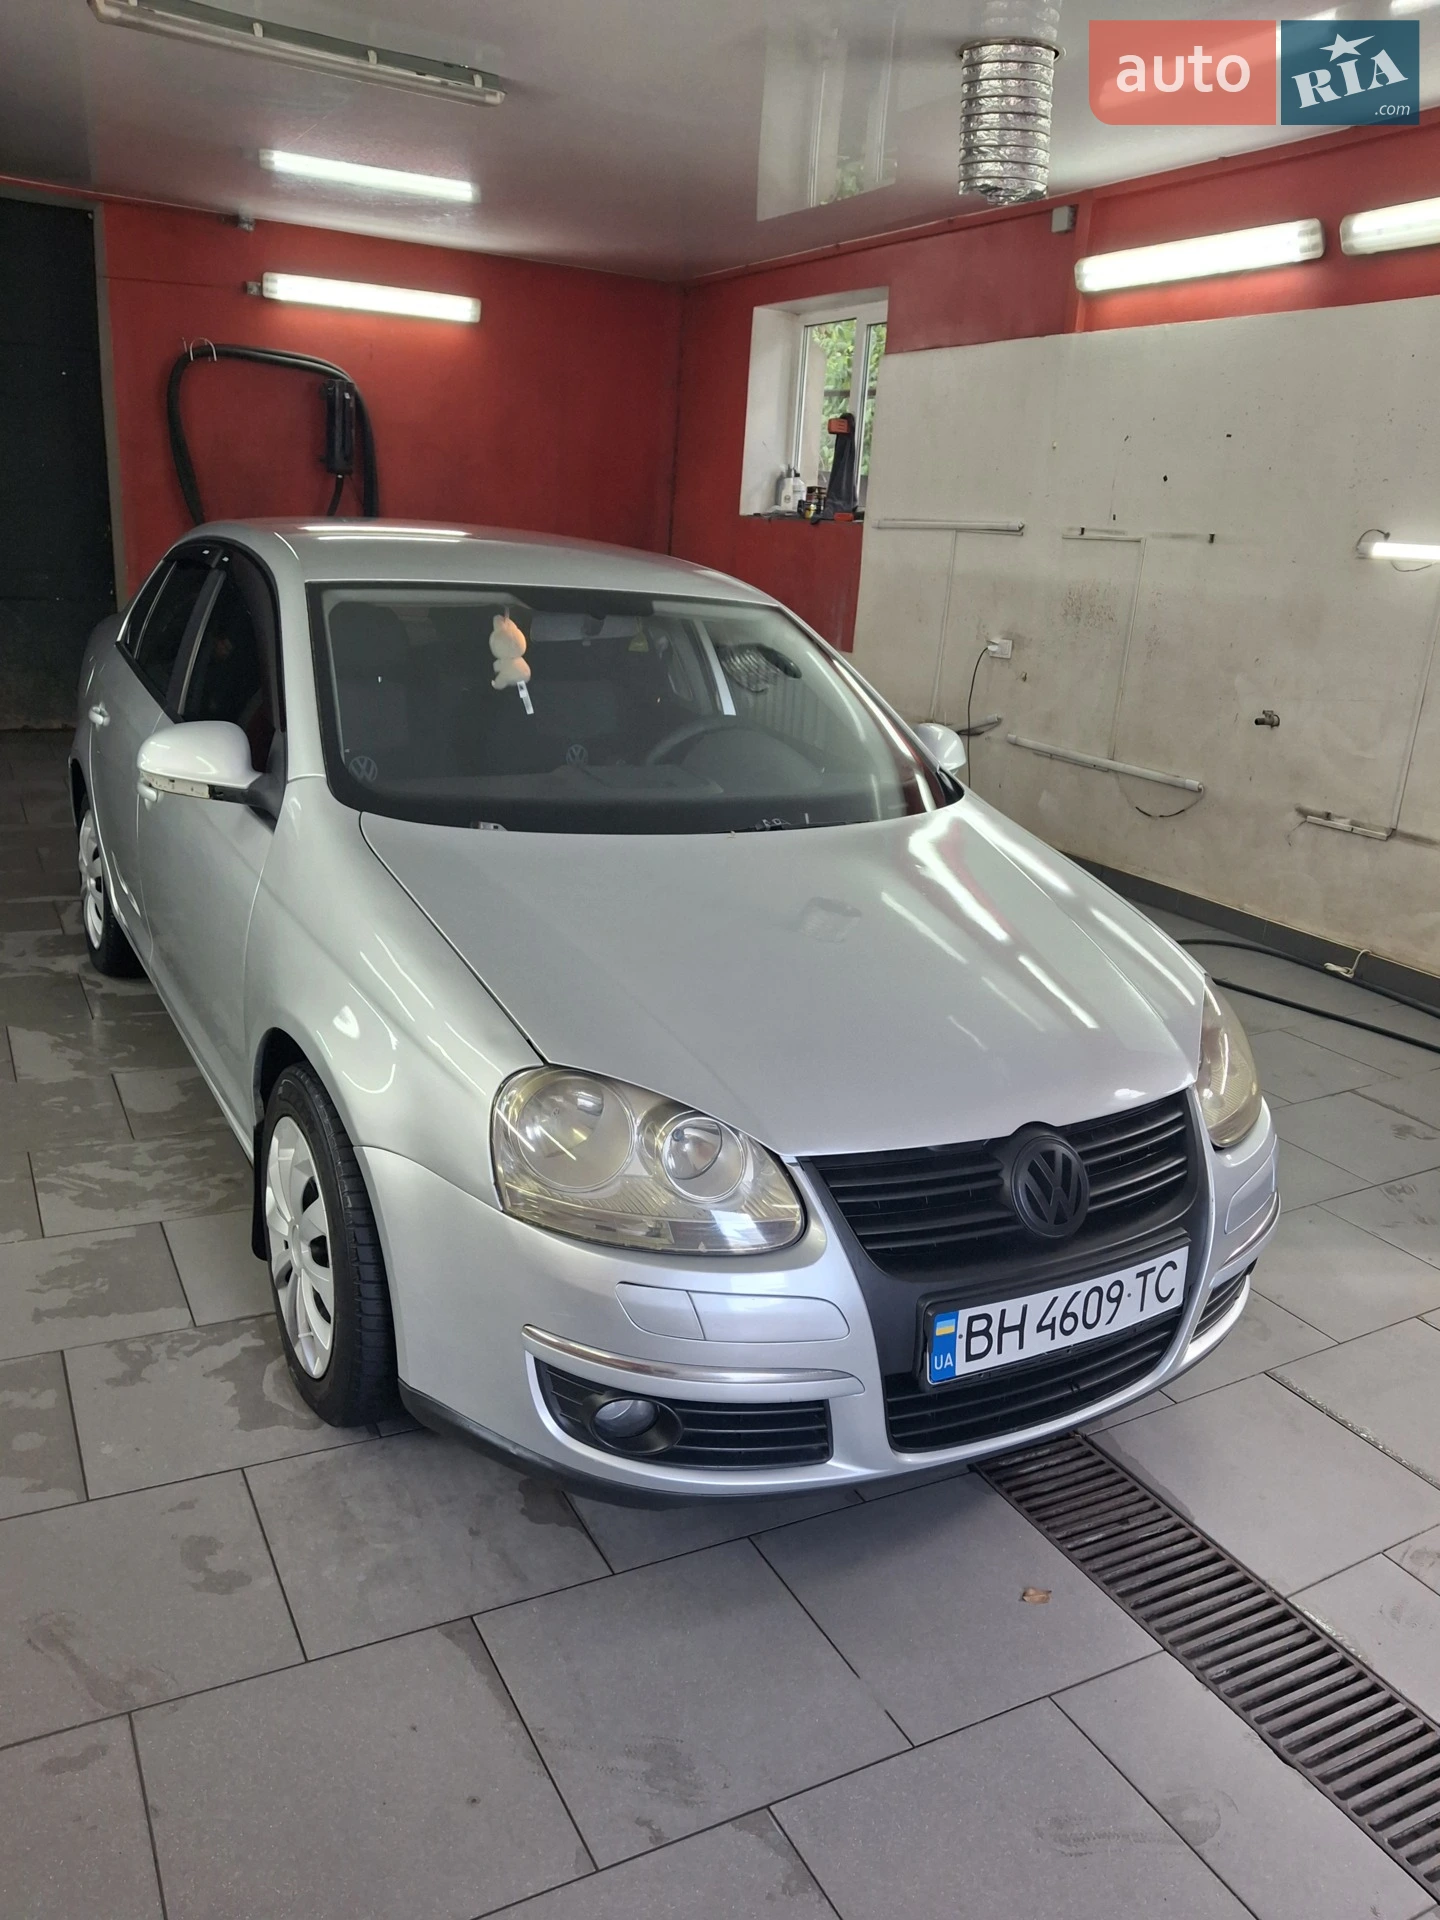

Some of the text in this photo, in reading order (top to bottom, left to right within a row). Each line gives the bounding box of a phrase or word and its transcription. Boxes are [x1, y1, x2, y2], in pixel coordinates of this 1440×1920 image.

[965, 1260, 1178, 1363] BH 4609 TC
[934, 1353, 954, 1370] UA
